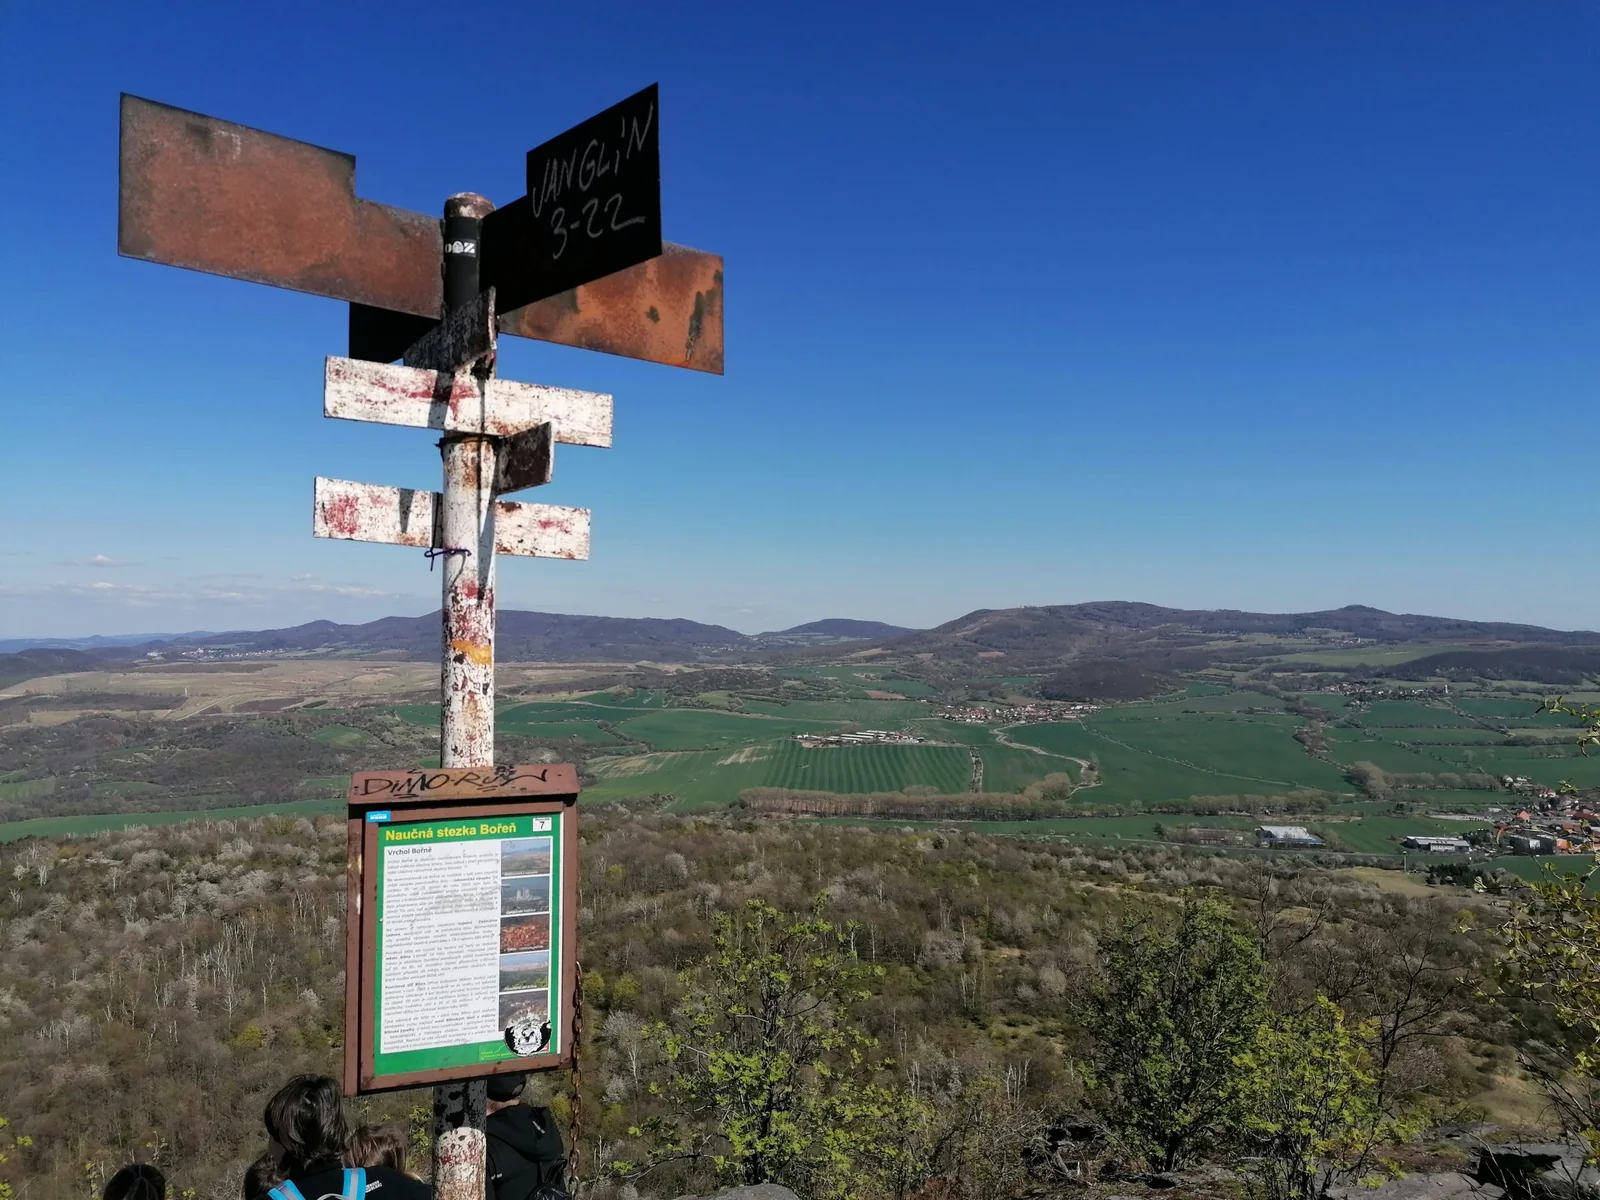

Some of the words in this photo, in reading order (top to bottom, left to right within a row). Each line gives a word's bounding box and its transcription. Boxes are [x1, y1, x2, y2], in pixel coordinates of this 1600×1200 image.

[551, 193, 645, 260] 3-22
[385, 828, 433, 841] Naučná
[437, 825, 476, 838] stezka
[480, 822, 516, 835] Bořeň
[539, 821, 545, 829] 7
[387, 848, 410, 856] Vrchol
